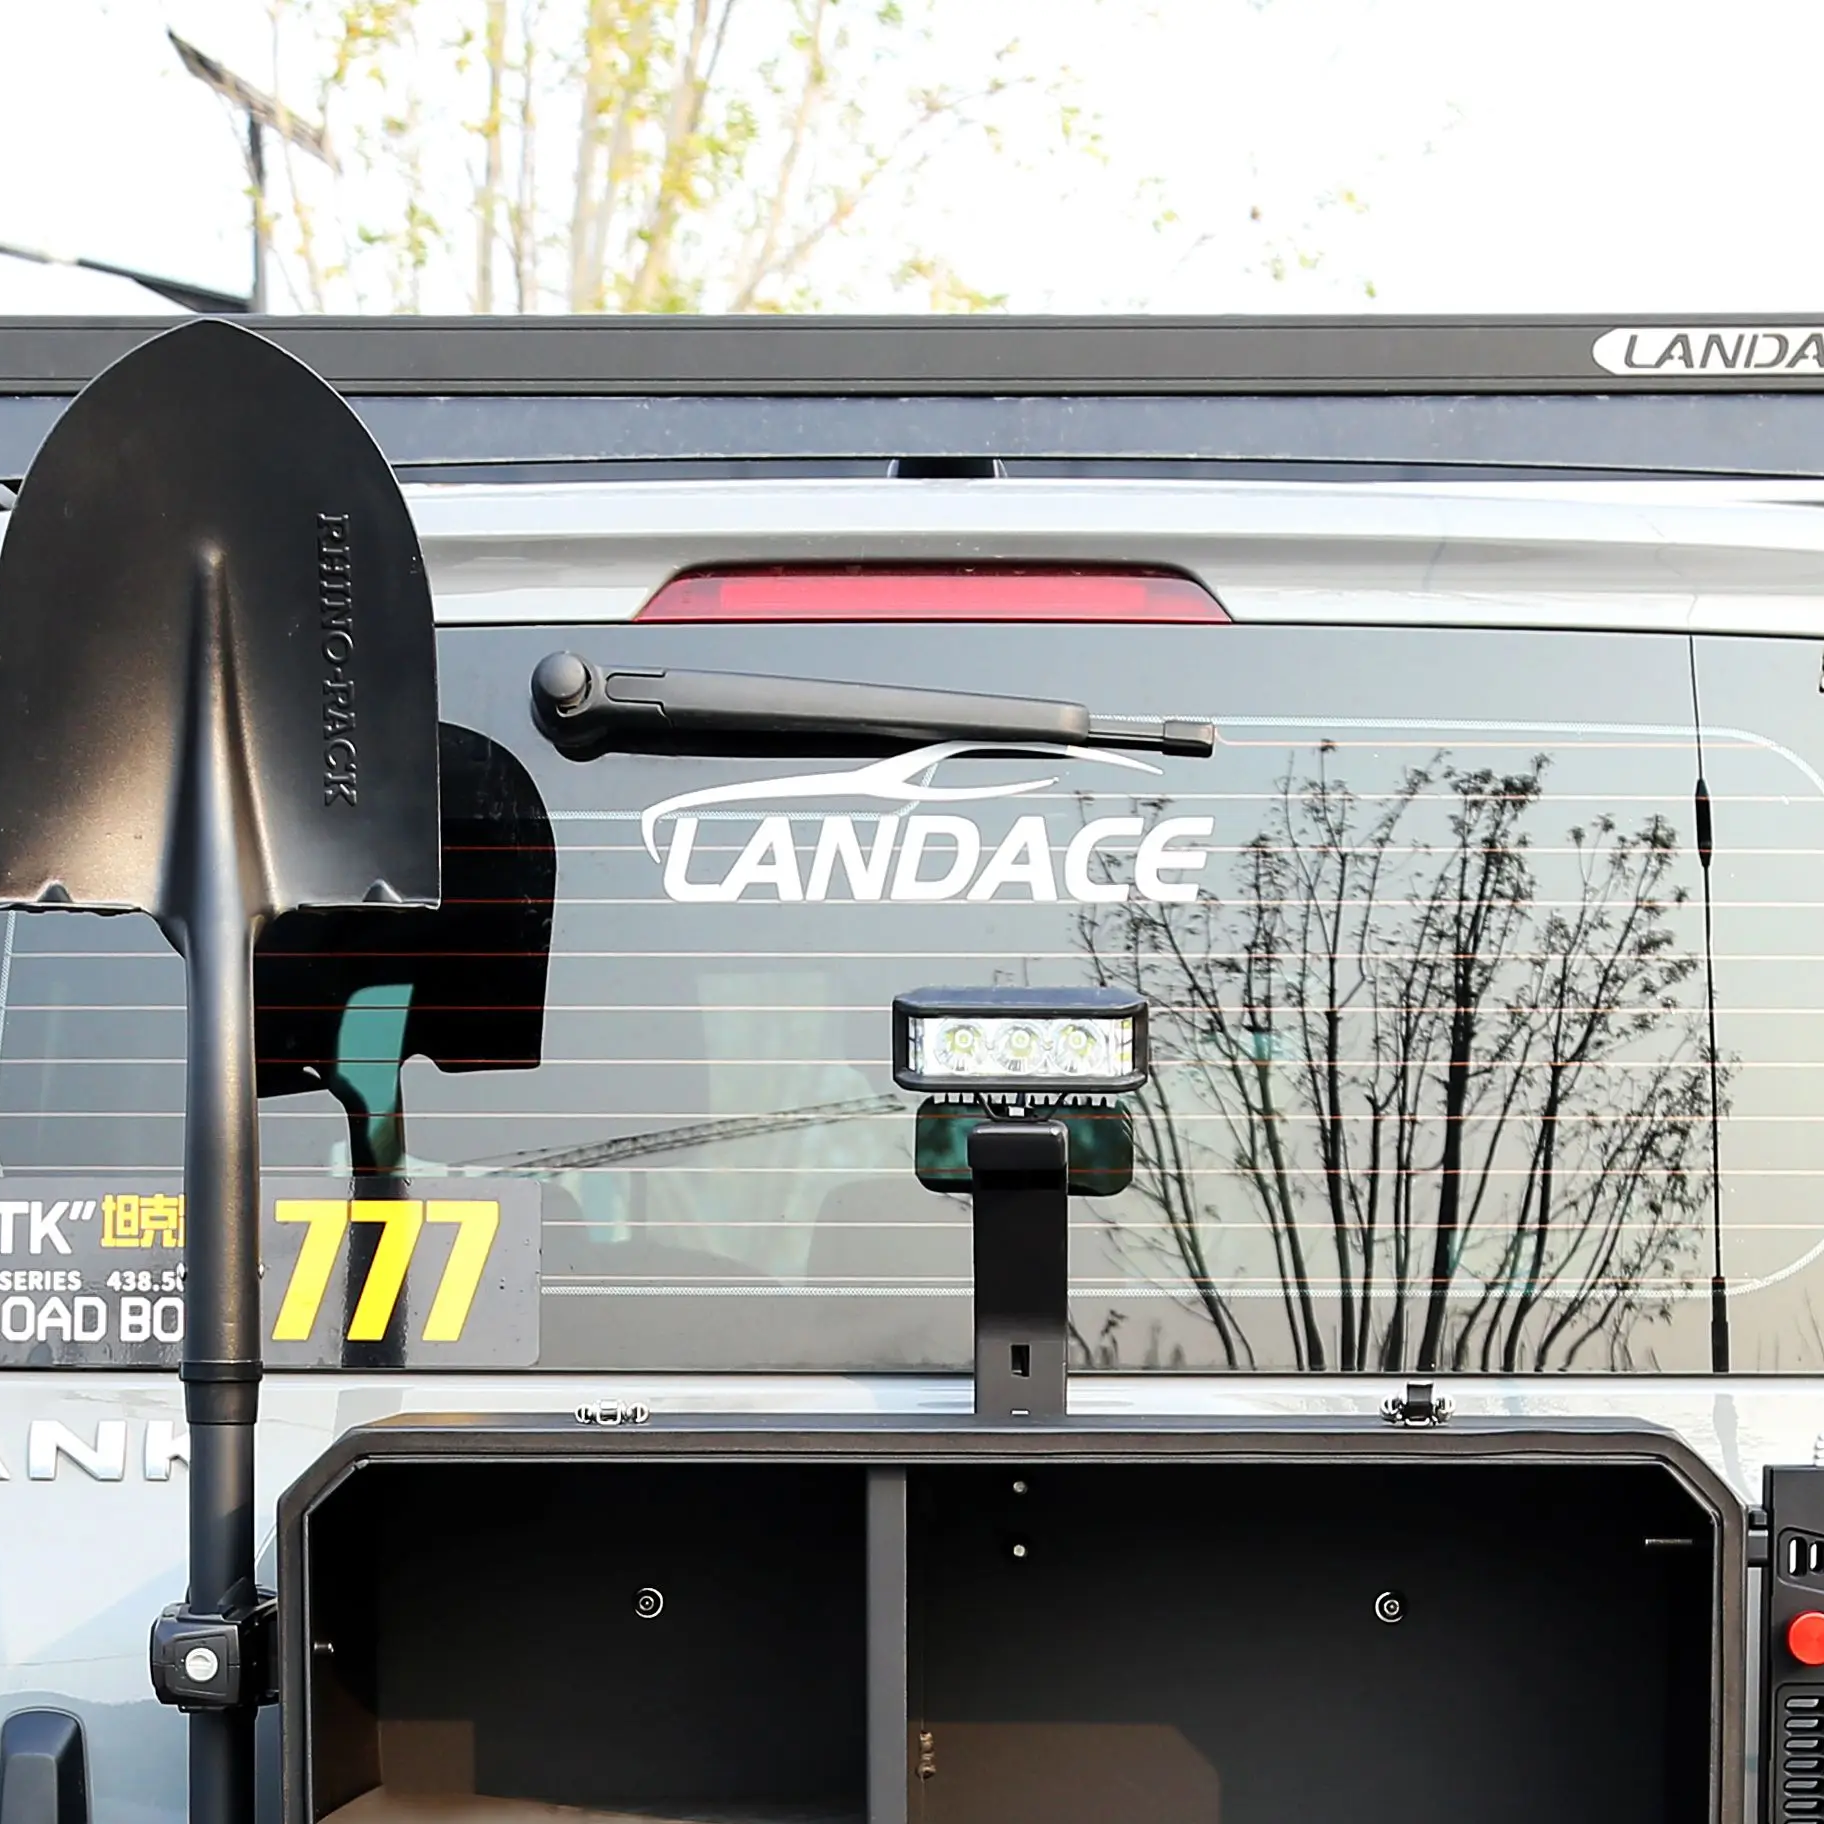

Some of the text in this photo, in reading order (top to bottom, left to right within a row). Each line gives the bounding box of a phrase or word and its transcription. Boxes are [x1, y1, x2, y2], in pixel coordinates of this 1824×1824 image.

[315, 510, 360, 808] RHINO-PACK
[662, 815, 1216, 903] LANDACE
[100, 1193, 185, 1249] 坦克
[271, 1197, 501, 1343] 777
